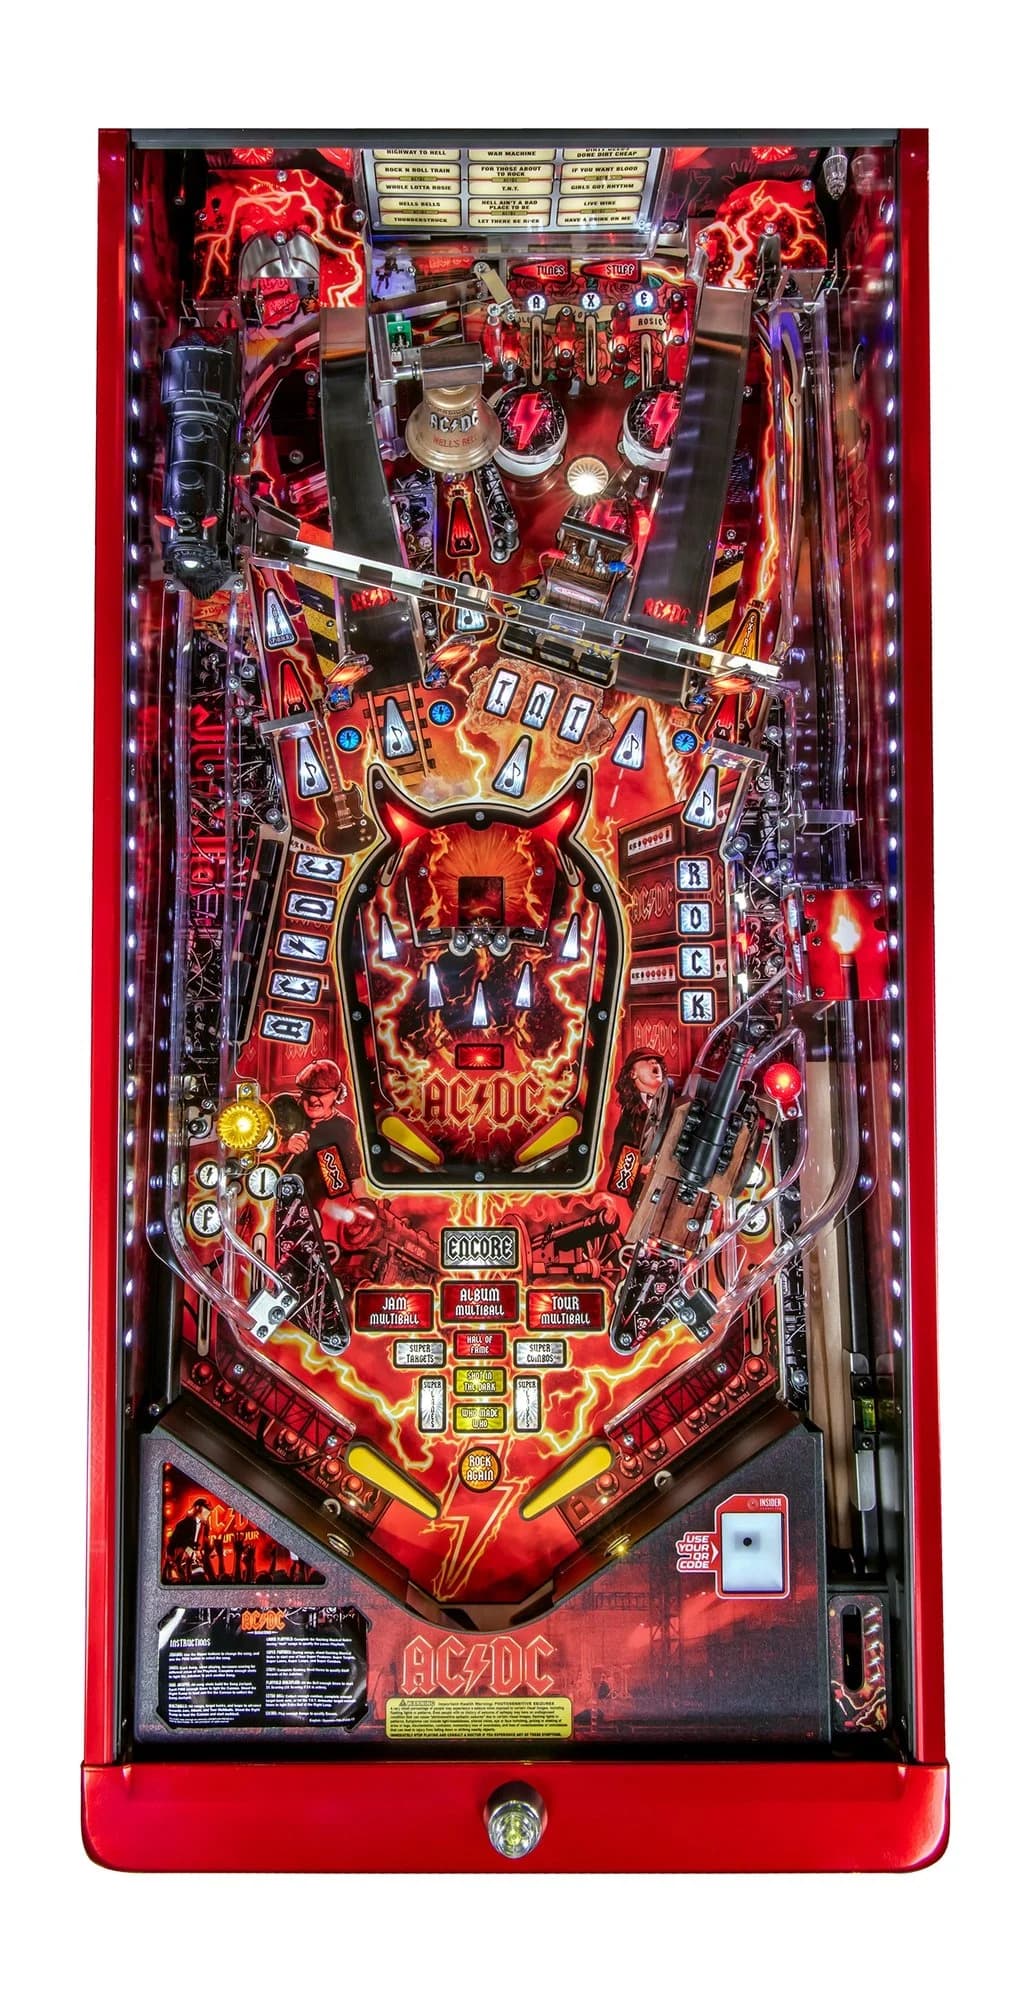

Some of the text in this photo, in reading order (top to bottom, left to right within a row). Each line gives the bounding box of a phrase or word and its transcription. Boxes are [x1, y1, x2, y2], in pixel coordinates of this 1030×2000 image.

[537, 264, 565, 277] TUNES
[606, 263, 634, 276] STUFF
[533, 290, 648, 309] A X E
[324, 1152, 344, 1190] 2X
[616, 1152, 636, 1191] 3X
[447, 1234, 514, 1261] ENCORE
[460, 1287, 501, 1302] ALBUM
[382, 1296, 408, 1311] JAM
[552, 1296, 580, 1311] TOUR
[455, 1303, 505, 1317] MULTIBALL
[369, 1313, 420, 1326] MULTIBALL
[540, 1313, 592, 1326] MULTIBALL
[466, 1335, 483, 1344] HALL
[409, 1343, 431, 1352] SUPER
[470, 1345, 490, 1354] FAME
[529, 1343, 551, 1352] SUPER
[406, 1354, 435, 1363] TARGETS
[423, 1381, 442, 1389] SUPER
[479, 1382, 496, 1392] DARK
[518, 1381, 538, 1389] SUPER
[479, 1408, 498, 1418] MADE
[472, 1419, 488, 1429] WHO
[469, 1455, 492, 1467] ROCK
[466, 1469, 494, 1481] AGAIN
[760, 1498, 782, 1507] INSIDER
[687, 1535, 710, 1544] USE
[679, 1543, 710, 1552] YOUR
[680, 1561, 710, 1569] CODE
